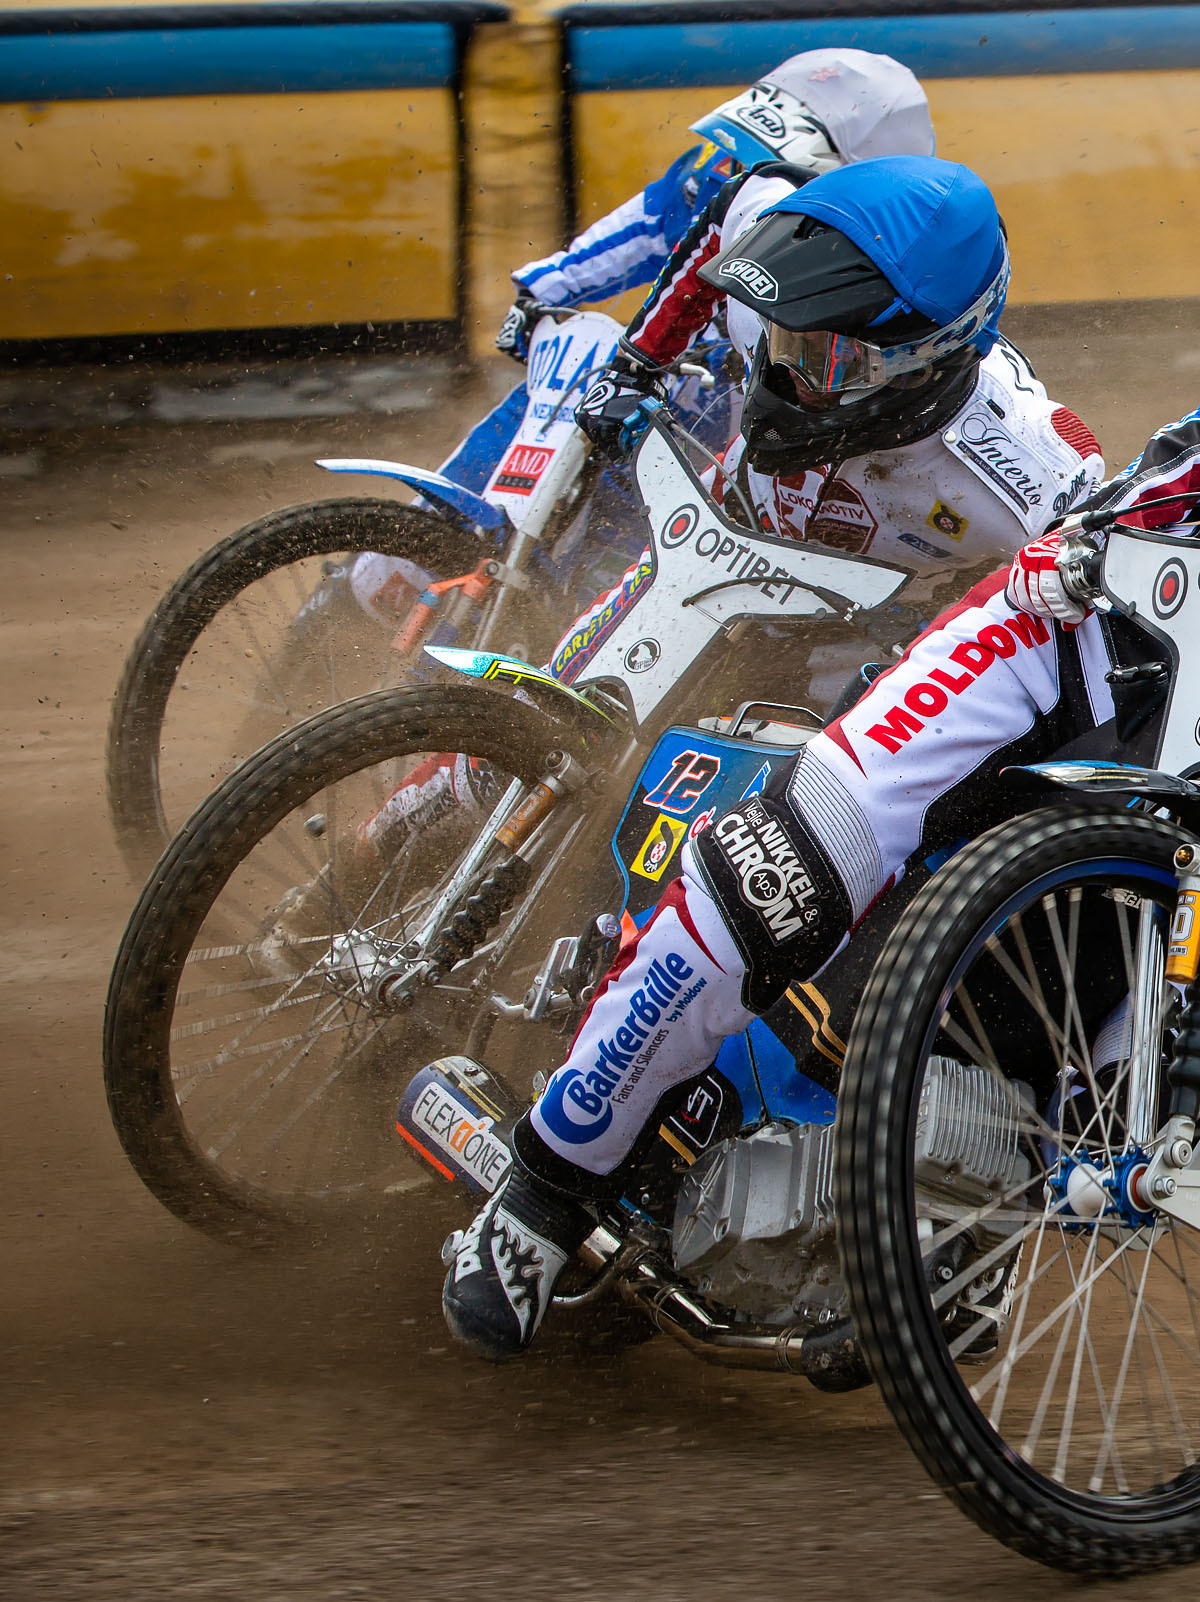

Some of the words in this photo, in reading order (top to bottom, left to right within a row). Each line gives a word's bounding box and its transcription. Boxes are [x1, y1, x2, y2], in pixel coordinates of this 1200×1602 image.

[748, 107, 781, 134] Arai
[722, 261, 775, 296] SHOEI
[504, 449, 549, 475] AMD
[961, 413, 1045, 506] Interio
[695, 528, 802, 605] OPTIBET
[556, 604, 613, 672] CARPETS
[864, 612, 1050, 755] MOLDOW
[643, 749, 720, 814] 12
[743, 803, 763, 828] Vejle
[715, 813, 804, 941] CHROM
[753, 872, 778, 899] ApS
[757, 821, 816, 909] NIKKEL
[804, 908, 818, 924] &
[665, 1010, 683, 1022] by
[675, 976, 708, 1010] Moldow
[566, 952, 694, 1117] BarkerBille
[612, 1084, 635, 1105] Fans
[627, 1064, 645, 1086] and
[639, 1028, 670, 1067] Silencers
